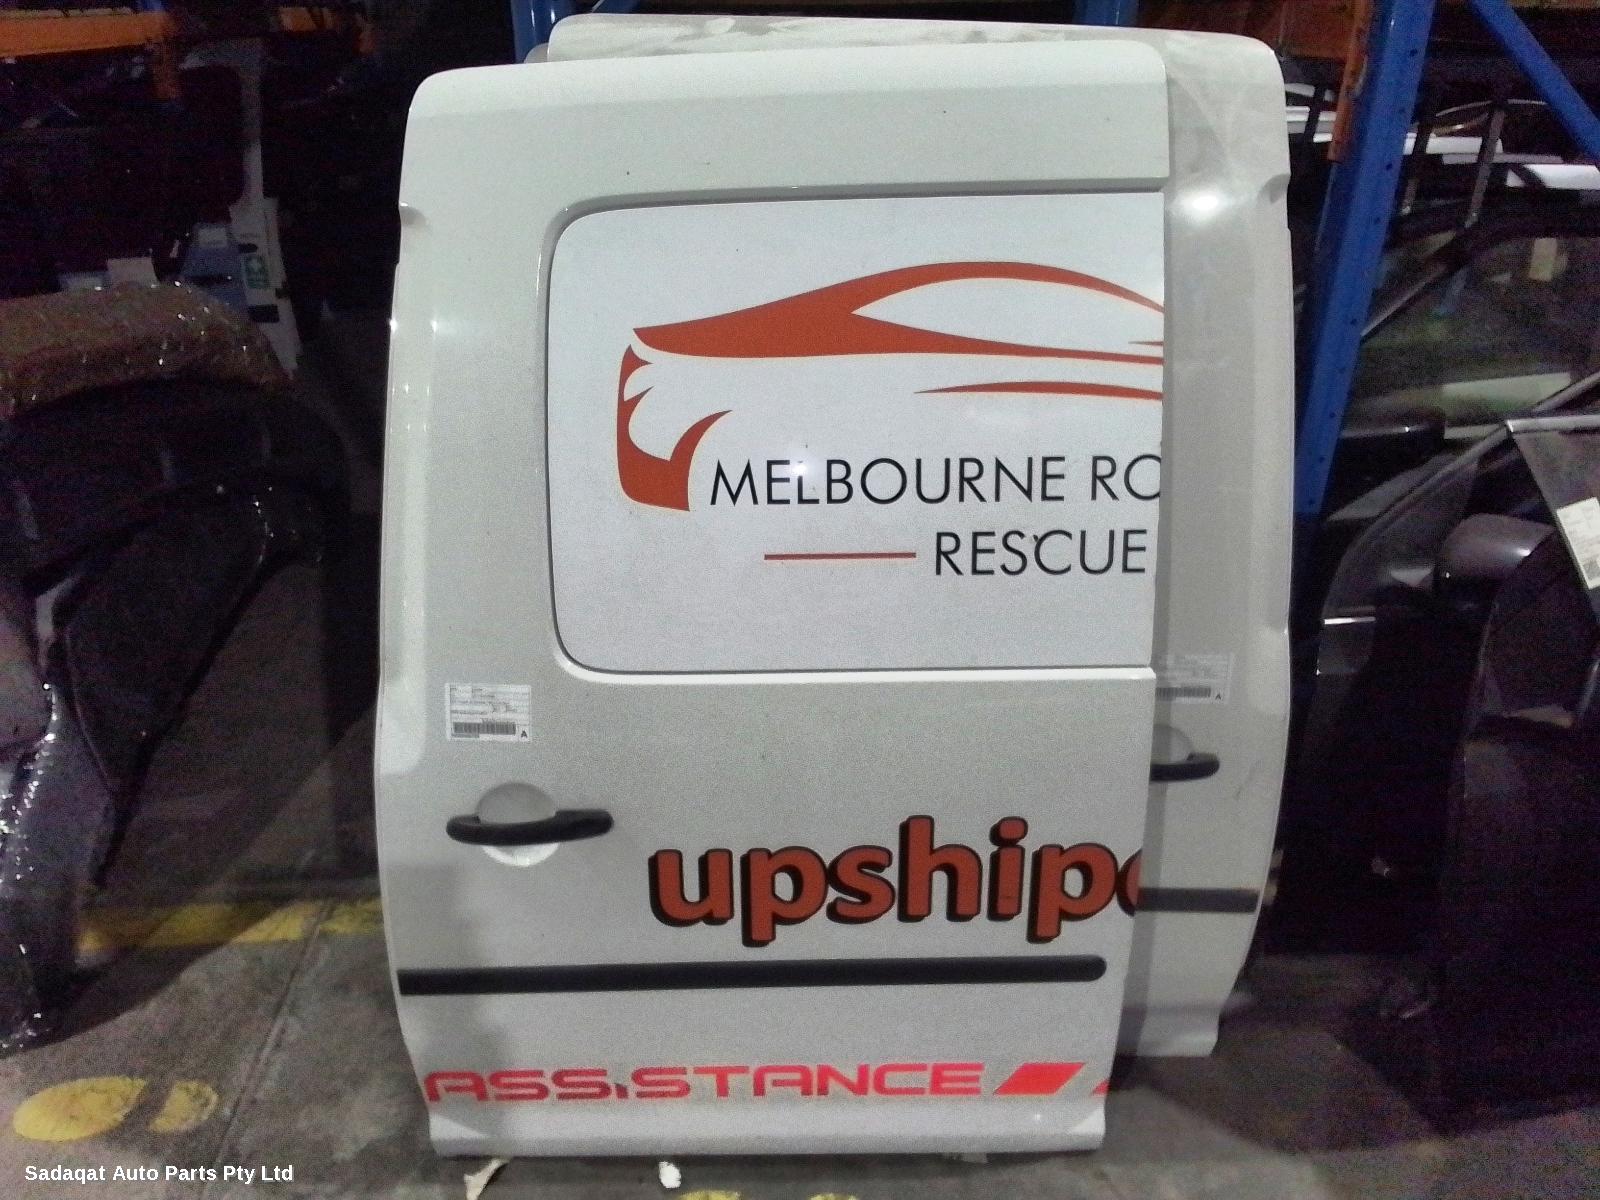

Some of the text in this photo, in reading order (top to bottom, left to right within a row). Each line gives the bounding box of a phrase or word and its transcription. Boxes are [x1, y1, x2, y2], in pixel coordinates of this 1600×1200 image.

[710, 454, 1162, 506] MELBOURNE RO
[934, 529, 1148, 576] RESCUE
[521, 730, 528, 739] A
